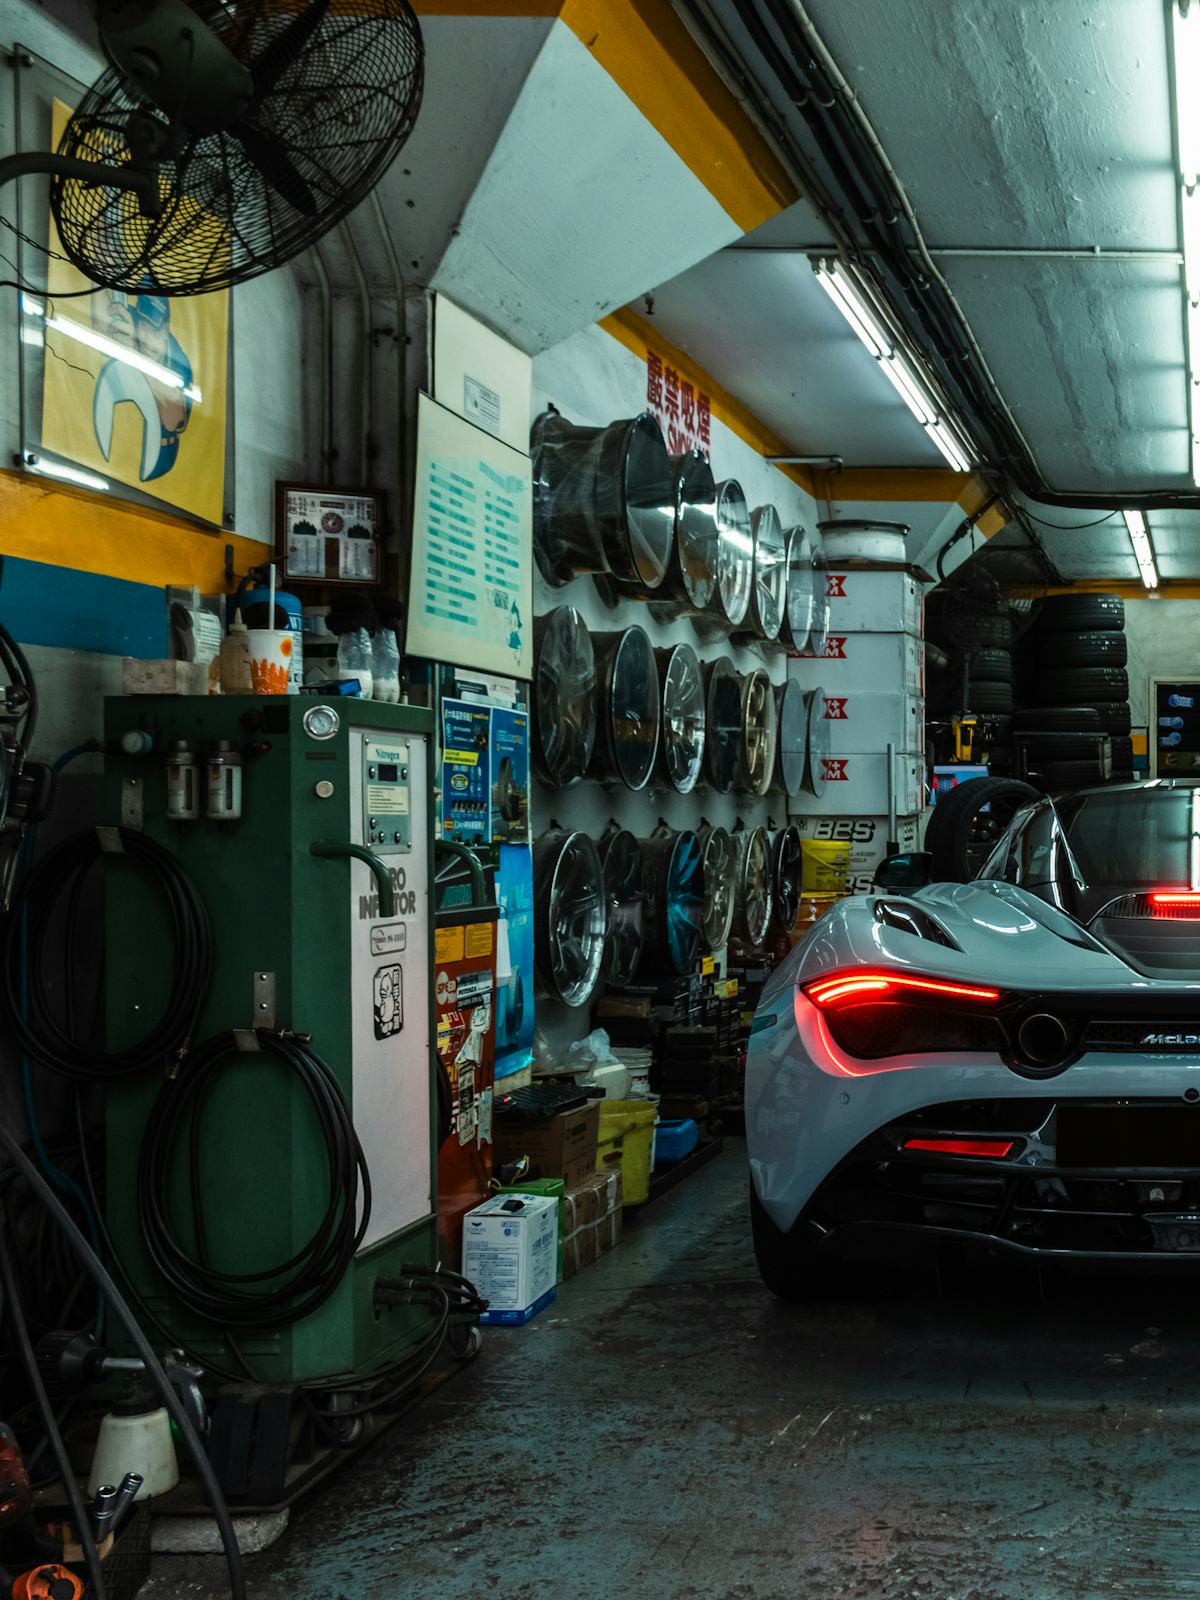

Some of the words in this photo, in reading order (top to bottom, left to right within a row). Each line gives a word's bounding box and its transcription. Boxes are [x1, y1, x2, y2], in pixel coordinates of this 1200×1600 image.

[375, 748, 400, 761] Nitrogen
[814, 819, 876, 842] BBS
[370, 867, 406, 892] NRO
[359, 890, 416, 920] INFTOR
